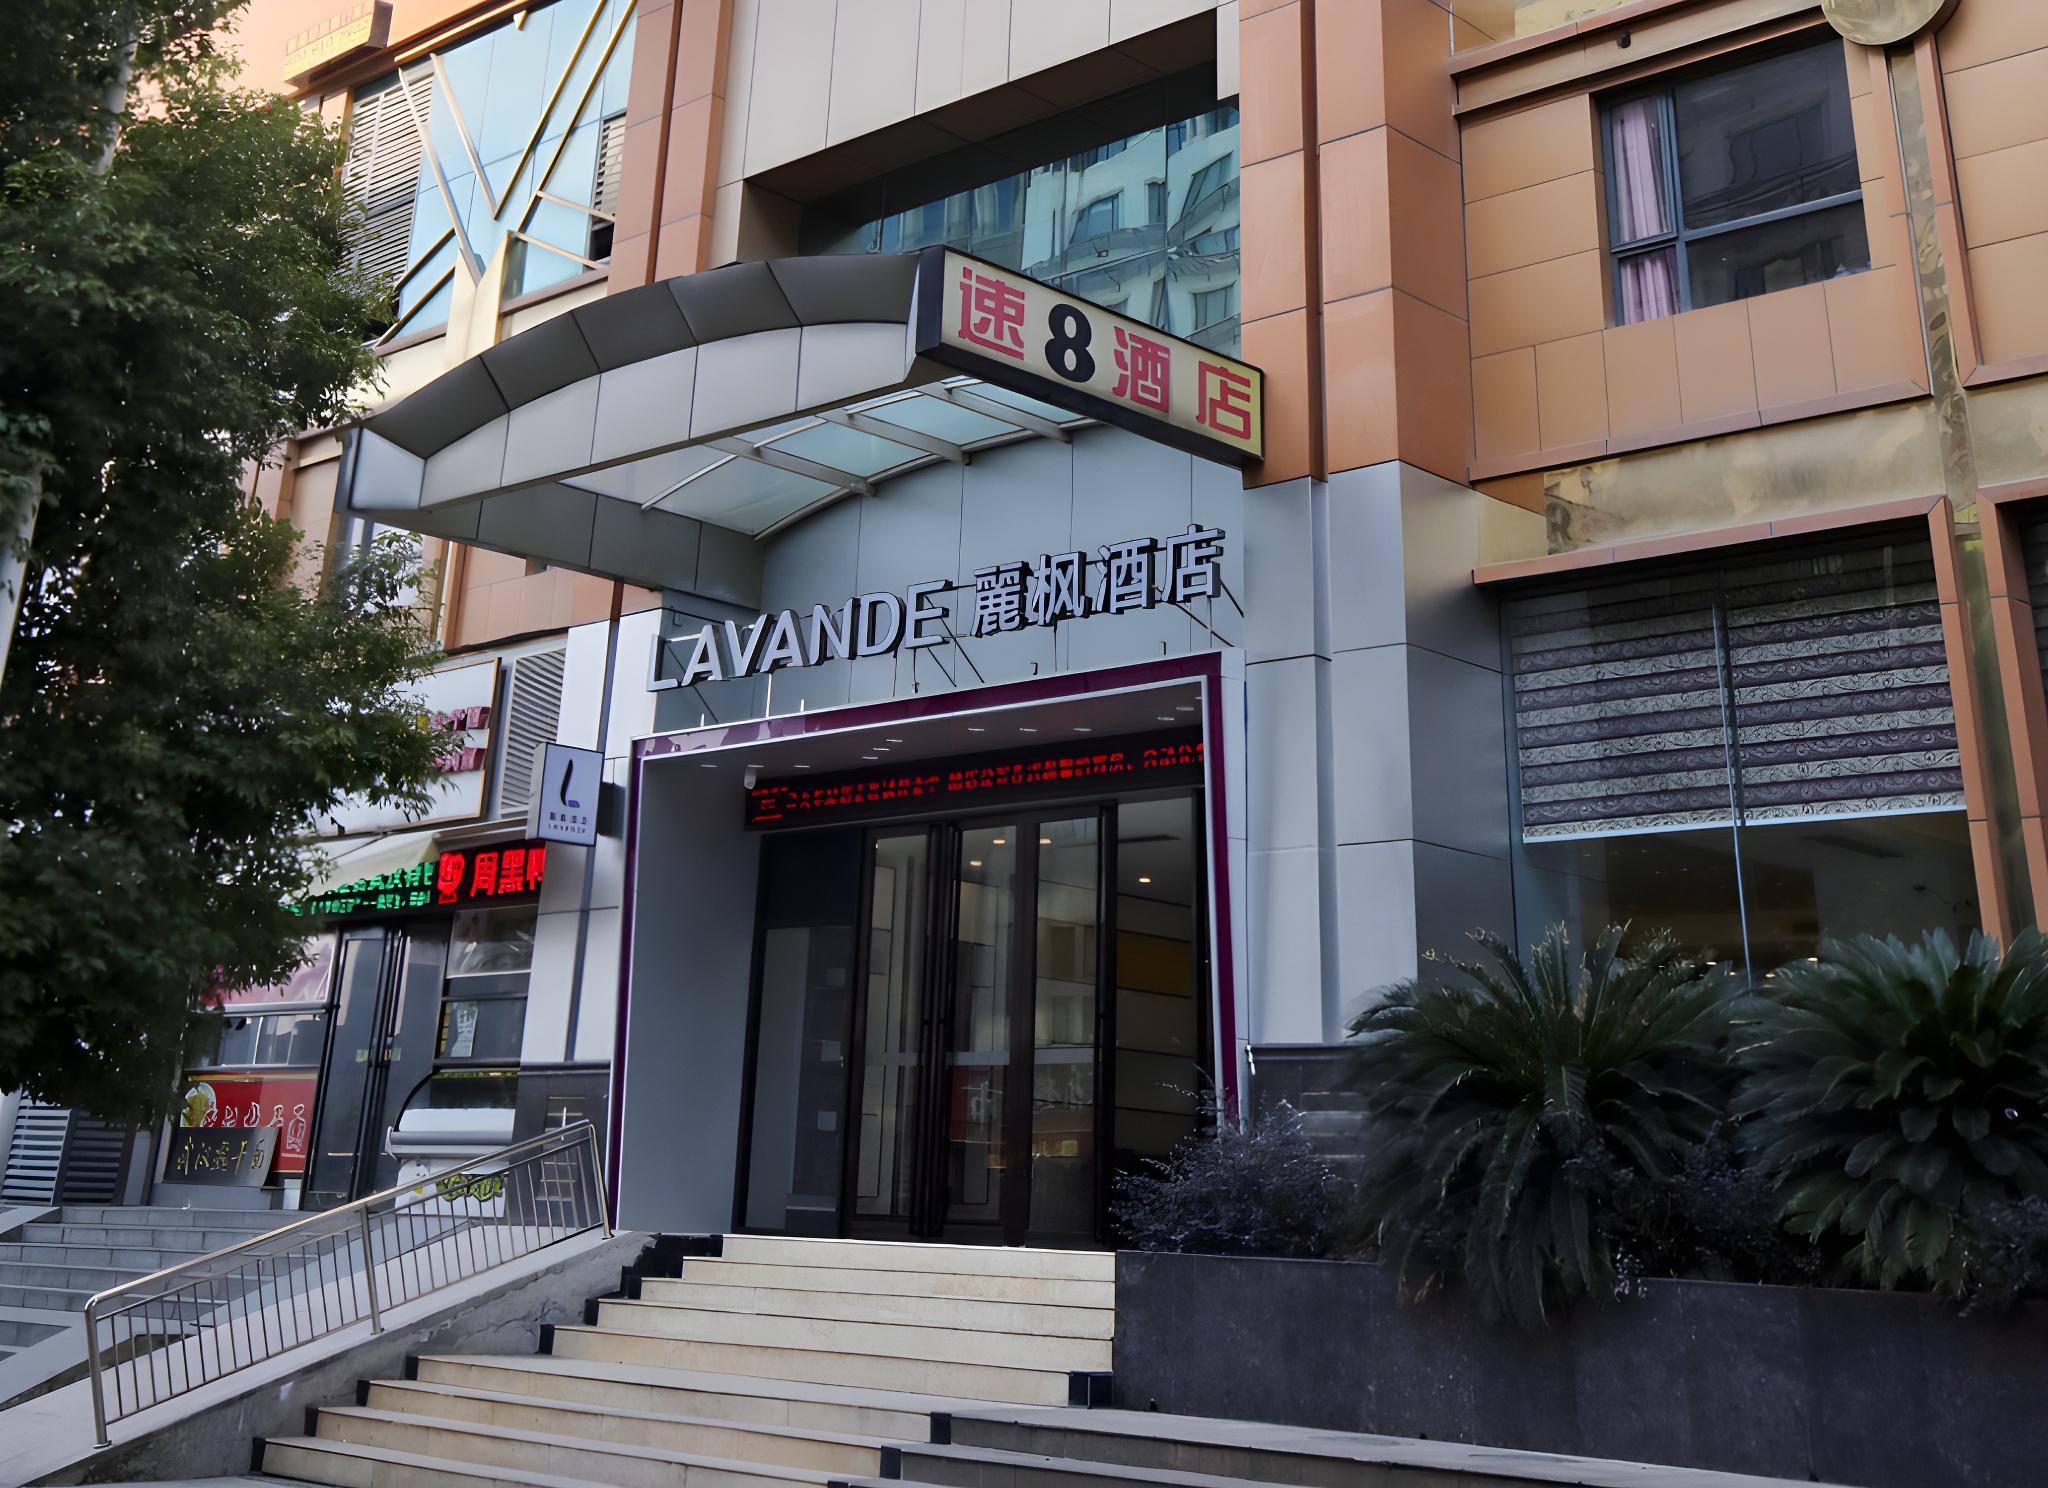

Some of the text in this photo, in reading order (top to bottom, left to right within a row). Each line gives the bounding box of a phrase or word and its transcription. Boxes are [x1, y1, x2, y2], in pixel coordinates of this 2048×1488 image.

[958, 266, 1252, 440] 速8酒店
[647, 523, 1226, 692] LAVANDE 麗枫酒店
